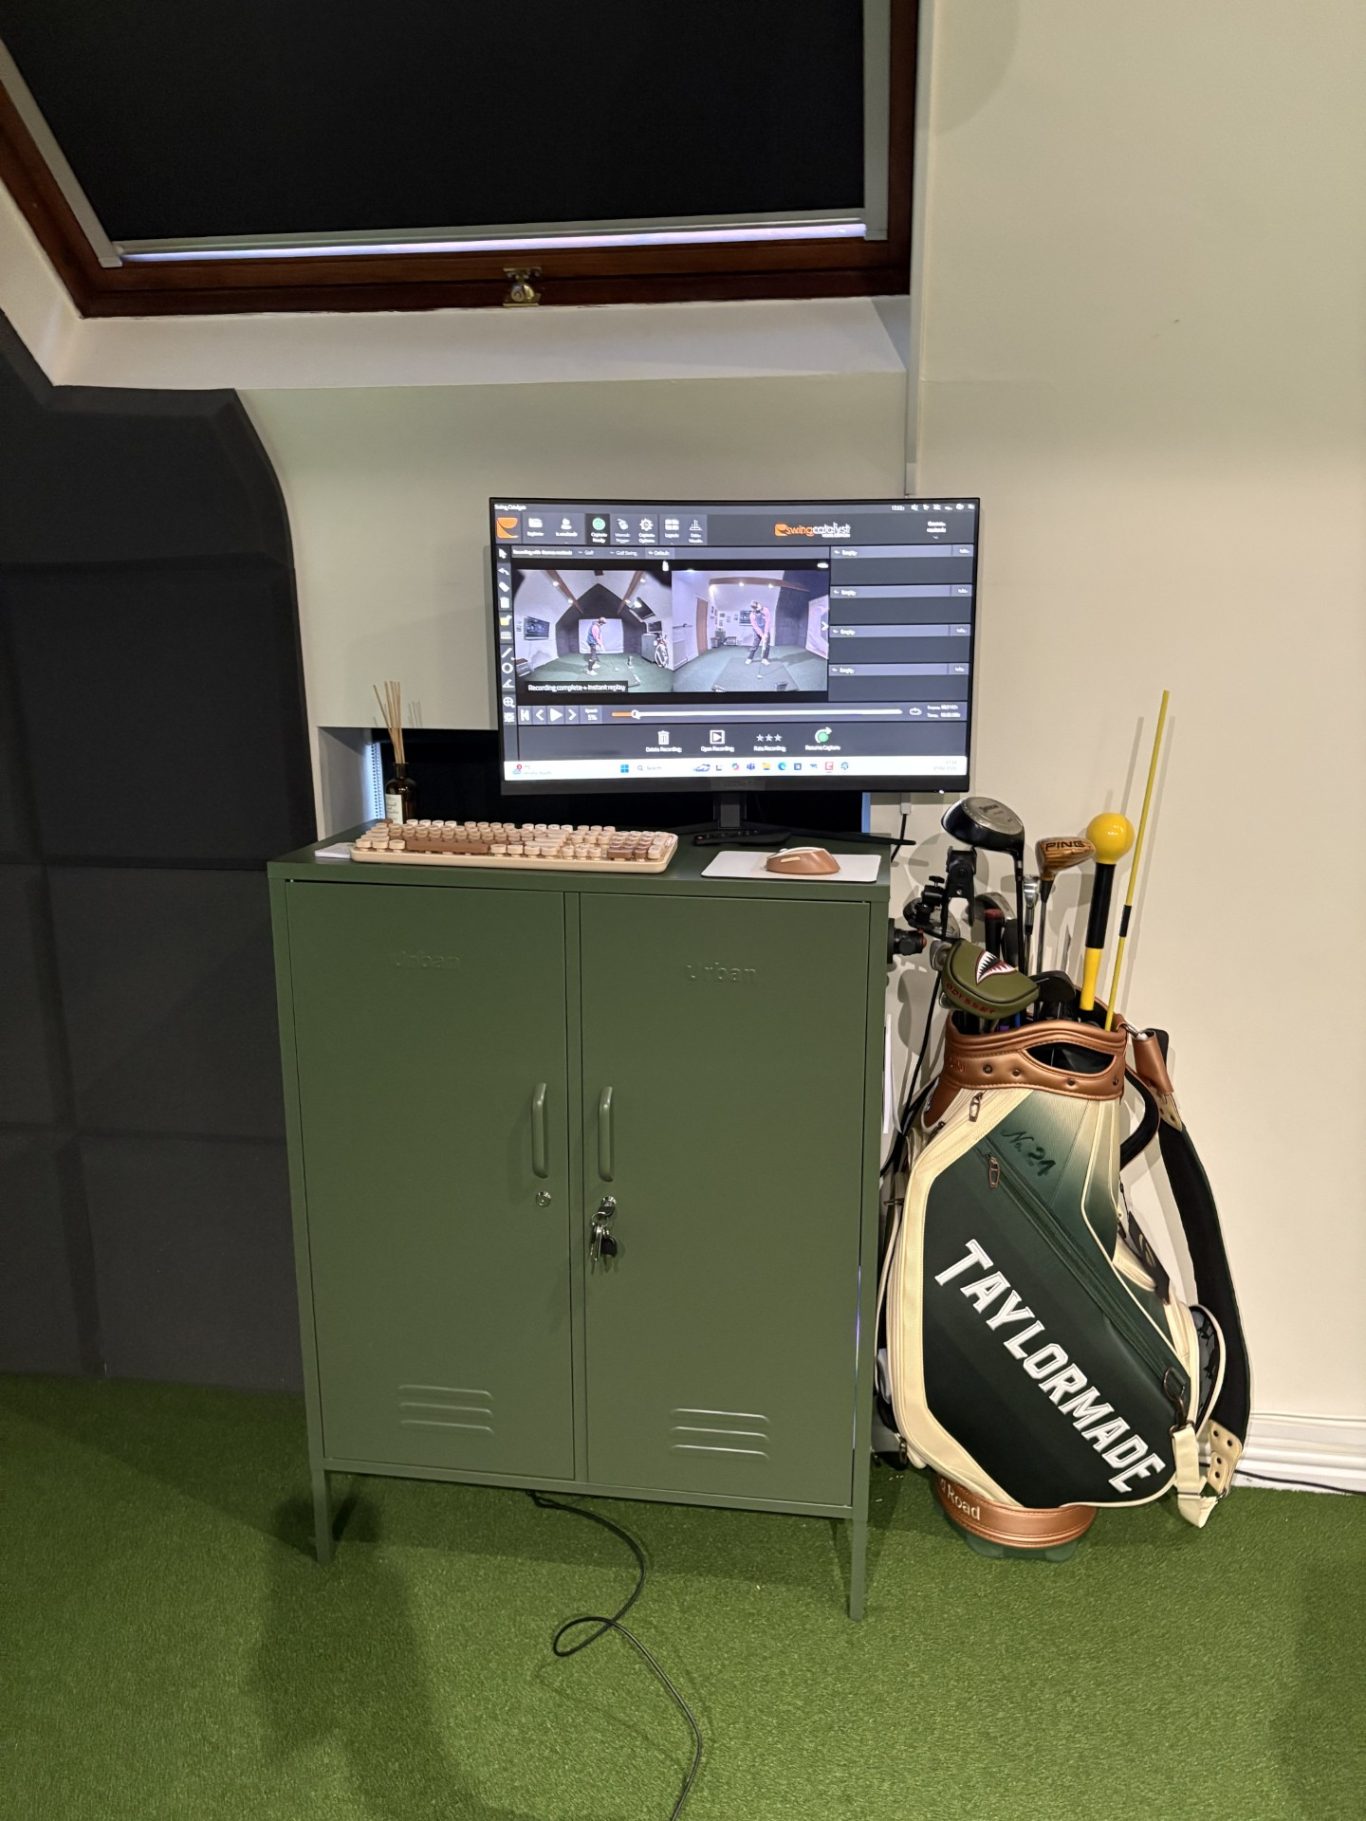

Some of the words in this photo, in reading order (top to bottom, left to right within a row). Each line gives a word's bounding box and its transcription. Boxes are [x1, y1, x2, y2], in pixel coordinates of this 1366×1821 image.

[527, 684, 557, 692] Recording
[557, 684, 582, 692] complete
[934, 1238, 1166, 1494] TAYLORMADE
